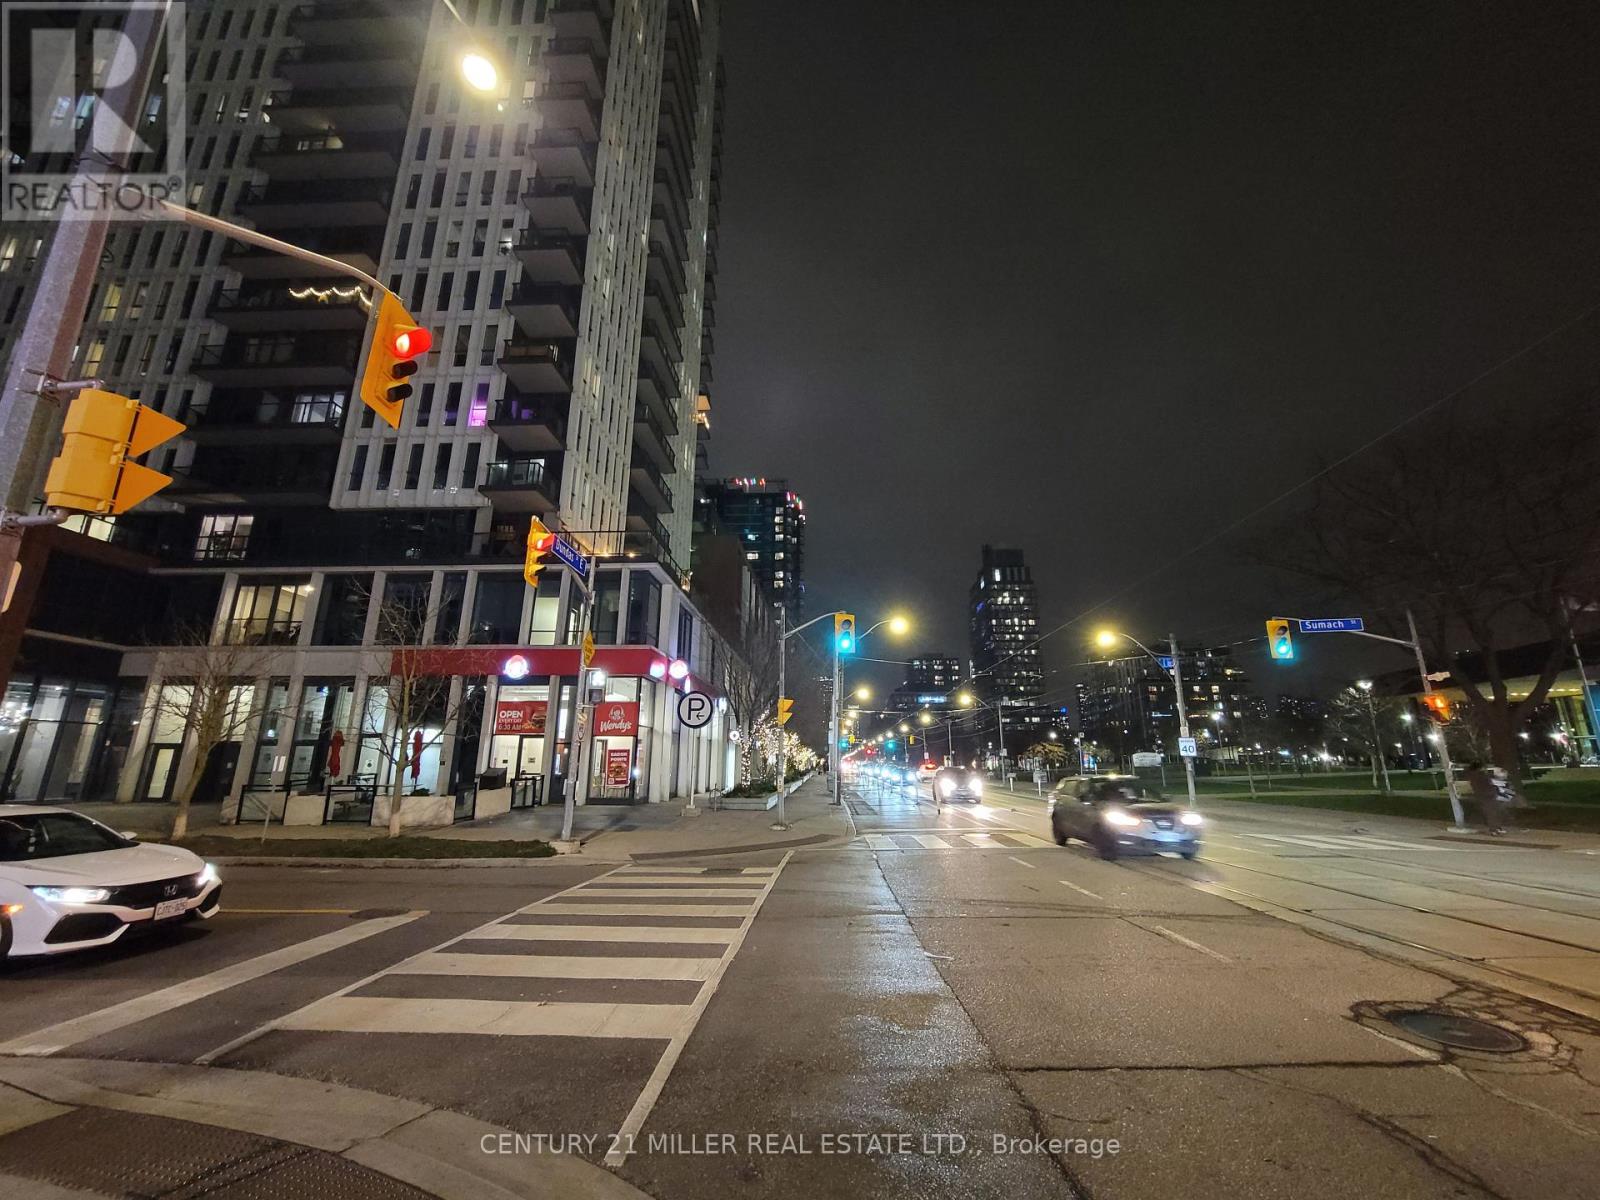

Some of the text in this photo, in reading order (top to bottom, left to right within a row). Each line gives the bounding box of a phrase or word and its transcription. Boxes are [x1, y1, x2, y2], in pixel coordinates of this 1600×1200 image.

[555, 538, 574, 562] Dundas
[1305, 620, 1345, 630] Sumach
[499, 710, 524, 719] OPEN
[687, 697, 706, 721] P
[600, 718, 633, 733] Wendy's
[1181, 745, 1195, 754] 40
